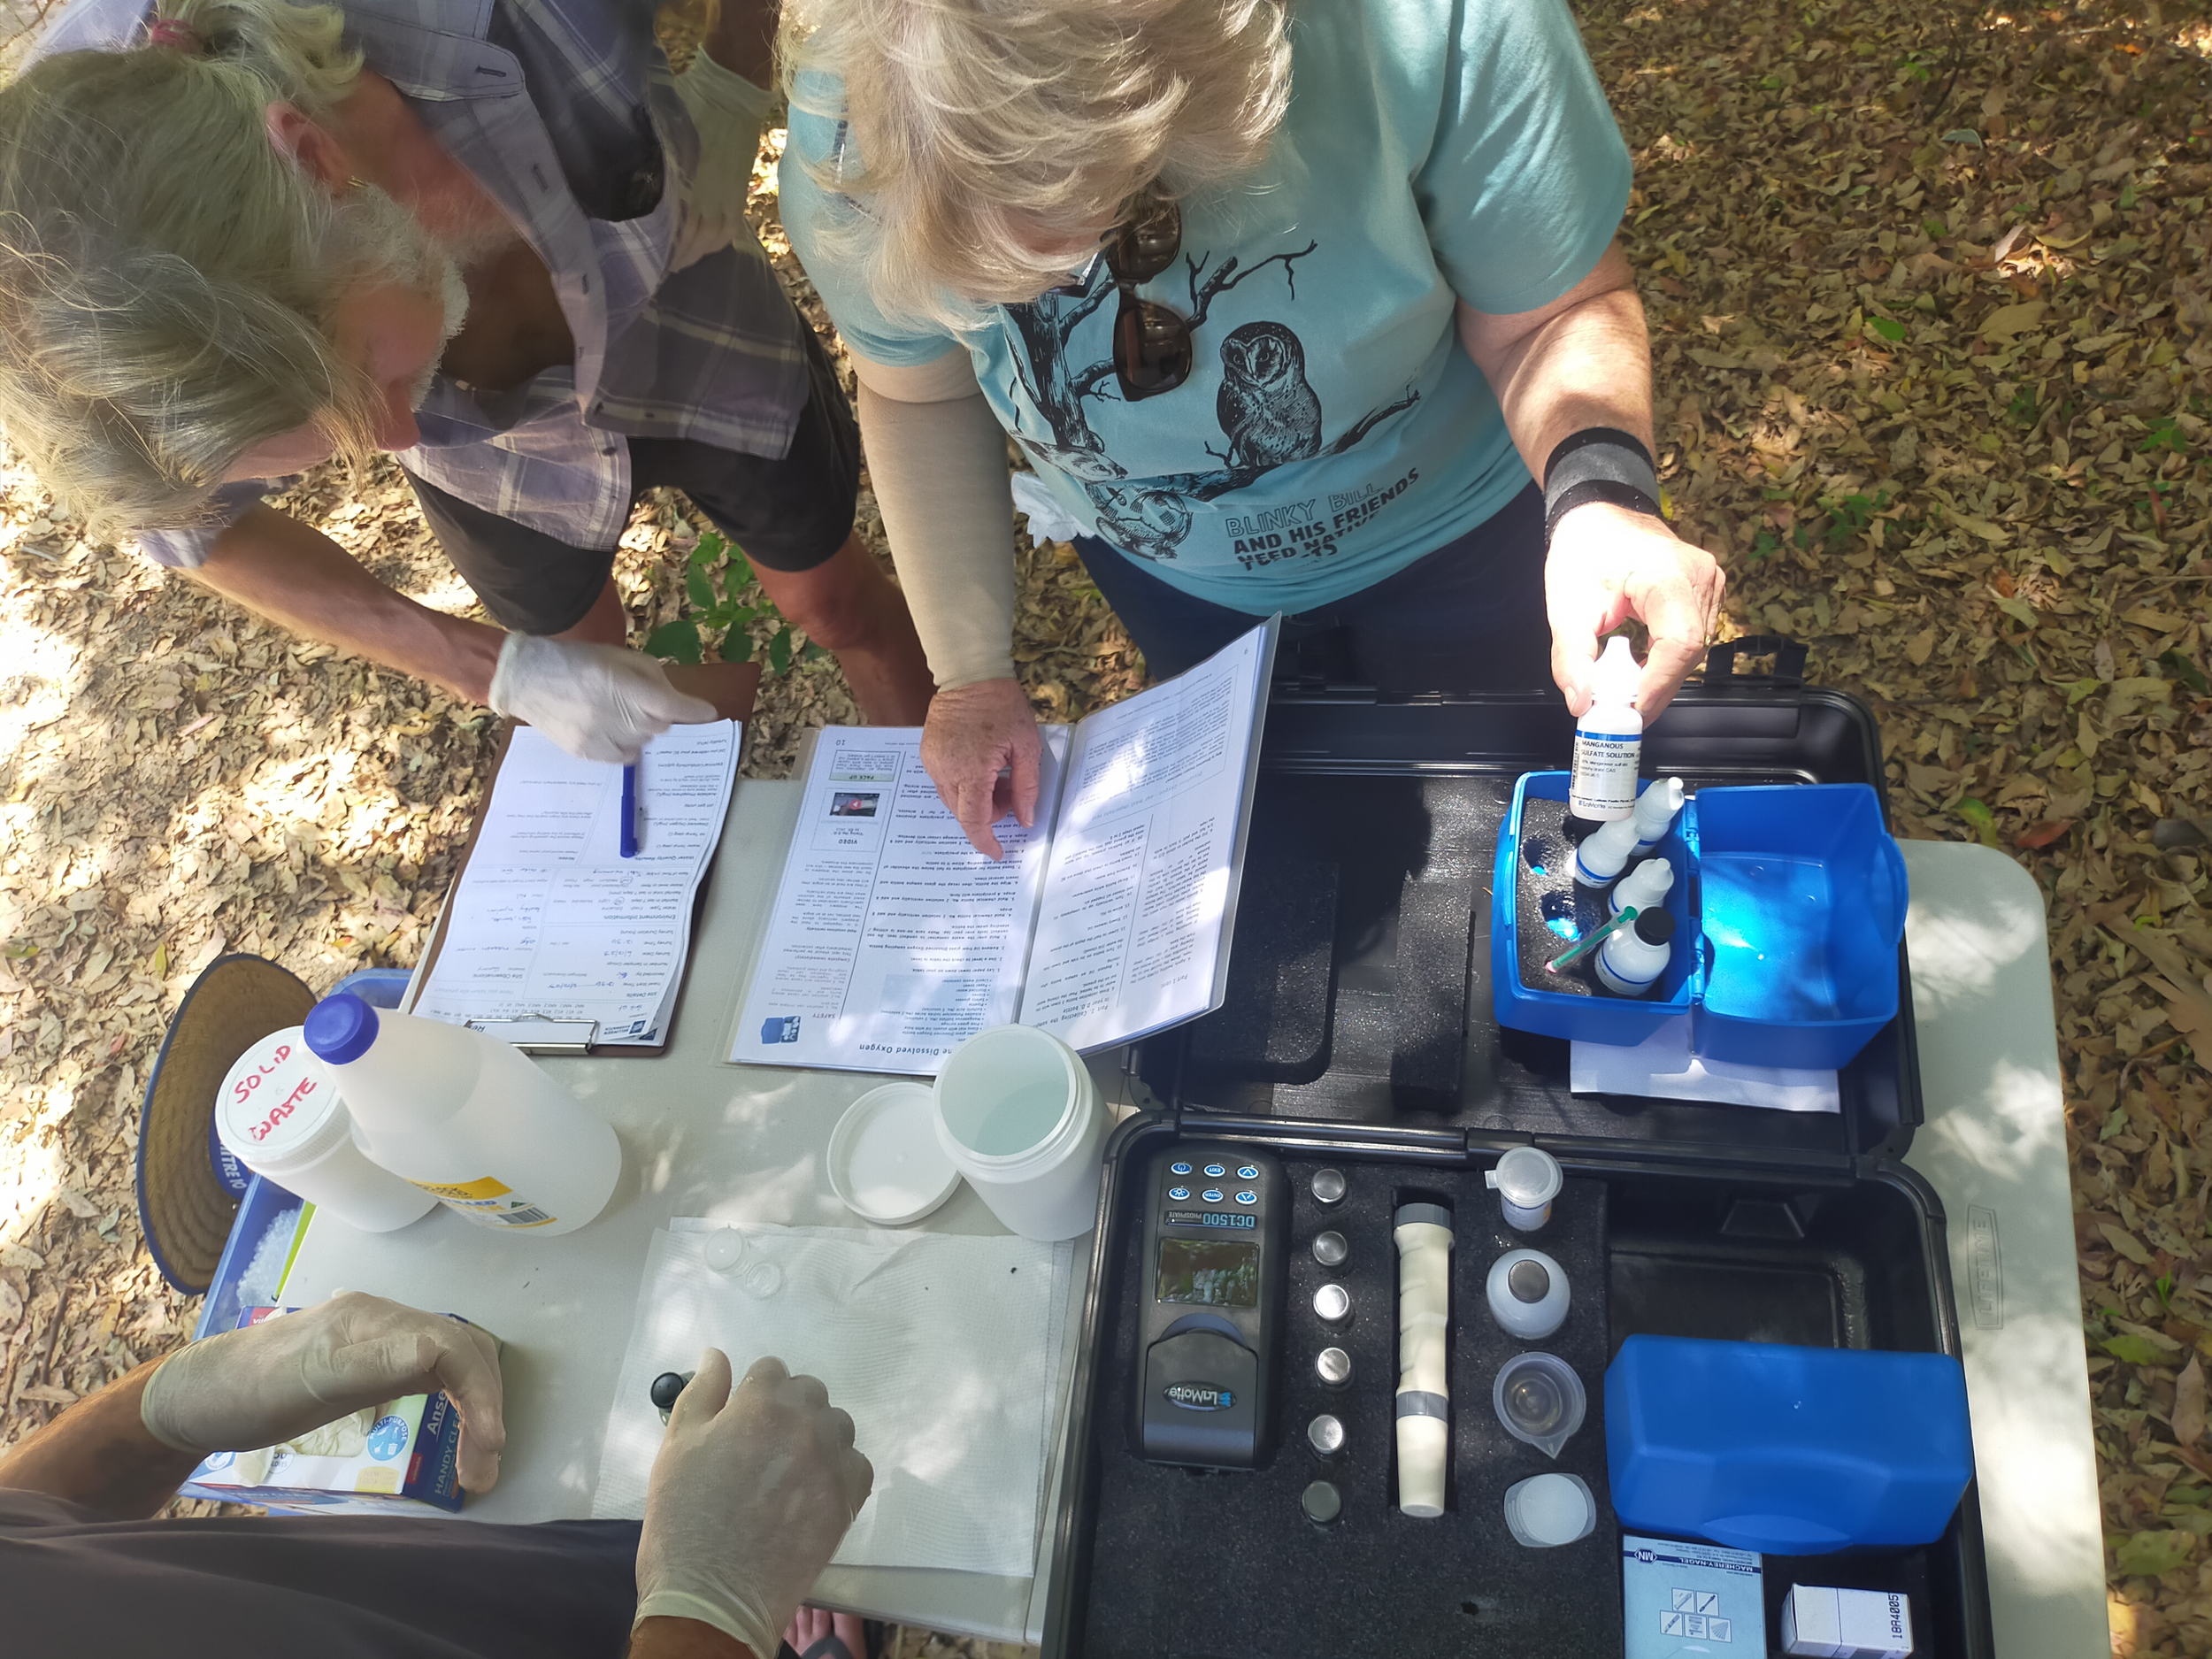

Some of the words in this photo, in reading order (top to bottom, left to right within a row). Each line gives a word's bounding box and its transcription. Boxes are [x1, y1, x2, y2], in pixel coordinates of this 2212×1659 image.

[1225, 499, 1316, 538] BLINKY
[1328, 483, 1383, 513] BILL
[1234, 534, 1281, 554] AND
[1290, 521, 1325, 542] HIS
[1333, 467, 1419, 530] FRIENDS
[1582, 740, 1624, 749] MANGANOUS
[1582, 800, 1606, 809] LaMotte
[858, 1042, 893, 1054] Oxygen
[895, 1046, 940, 1056] Dissolved
[234, 1045, 292, 1104] SOLID
[248, 1076, 318, 1141] WASTE
[1168, 1210, 1202, 1220] PHOSPHATE
[1202, 1212, 1255, 1228] DC1500
[1167, 1386, 1217, 1406] LaMotte
[426, 1389, 447, 1436] Anse
[369, 1416, 408, 1440] MULTI-PURPOSE
[434, 1449, 455, 1495] HANDY
[1638, 1550, 1653, 1560] MN
[1678, 1556, 1753, 1571] MACHEREY-NAGEL
